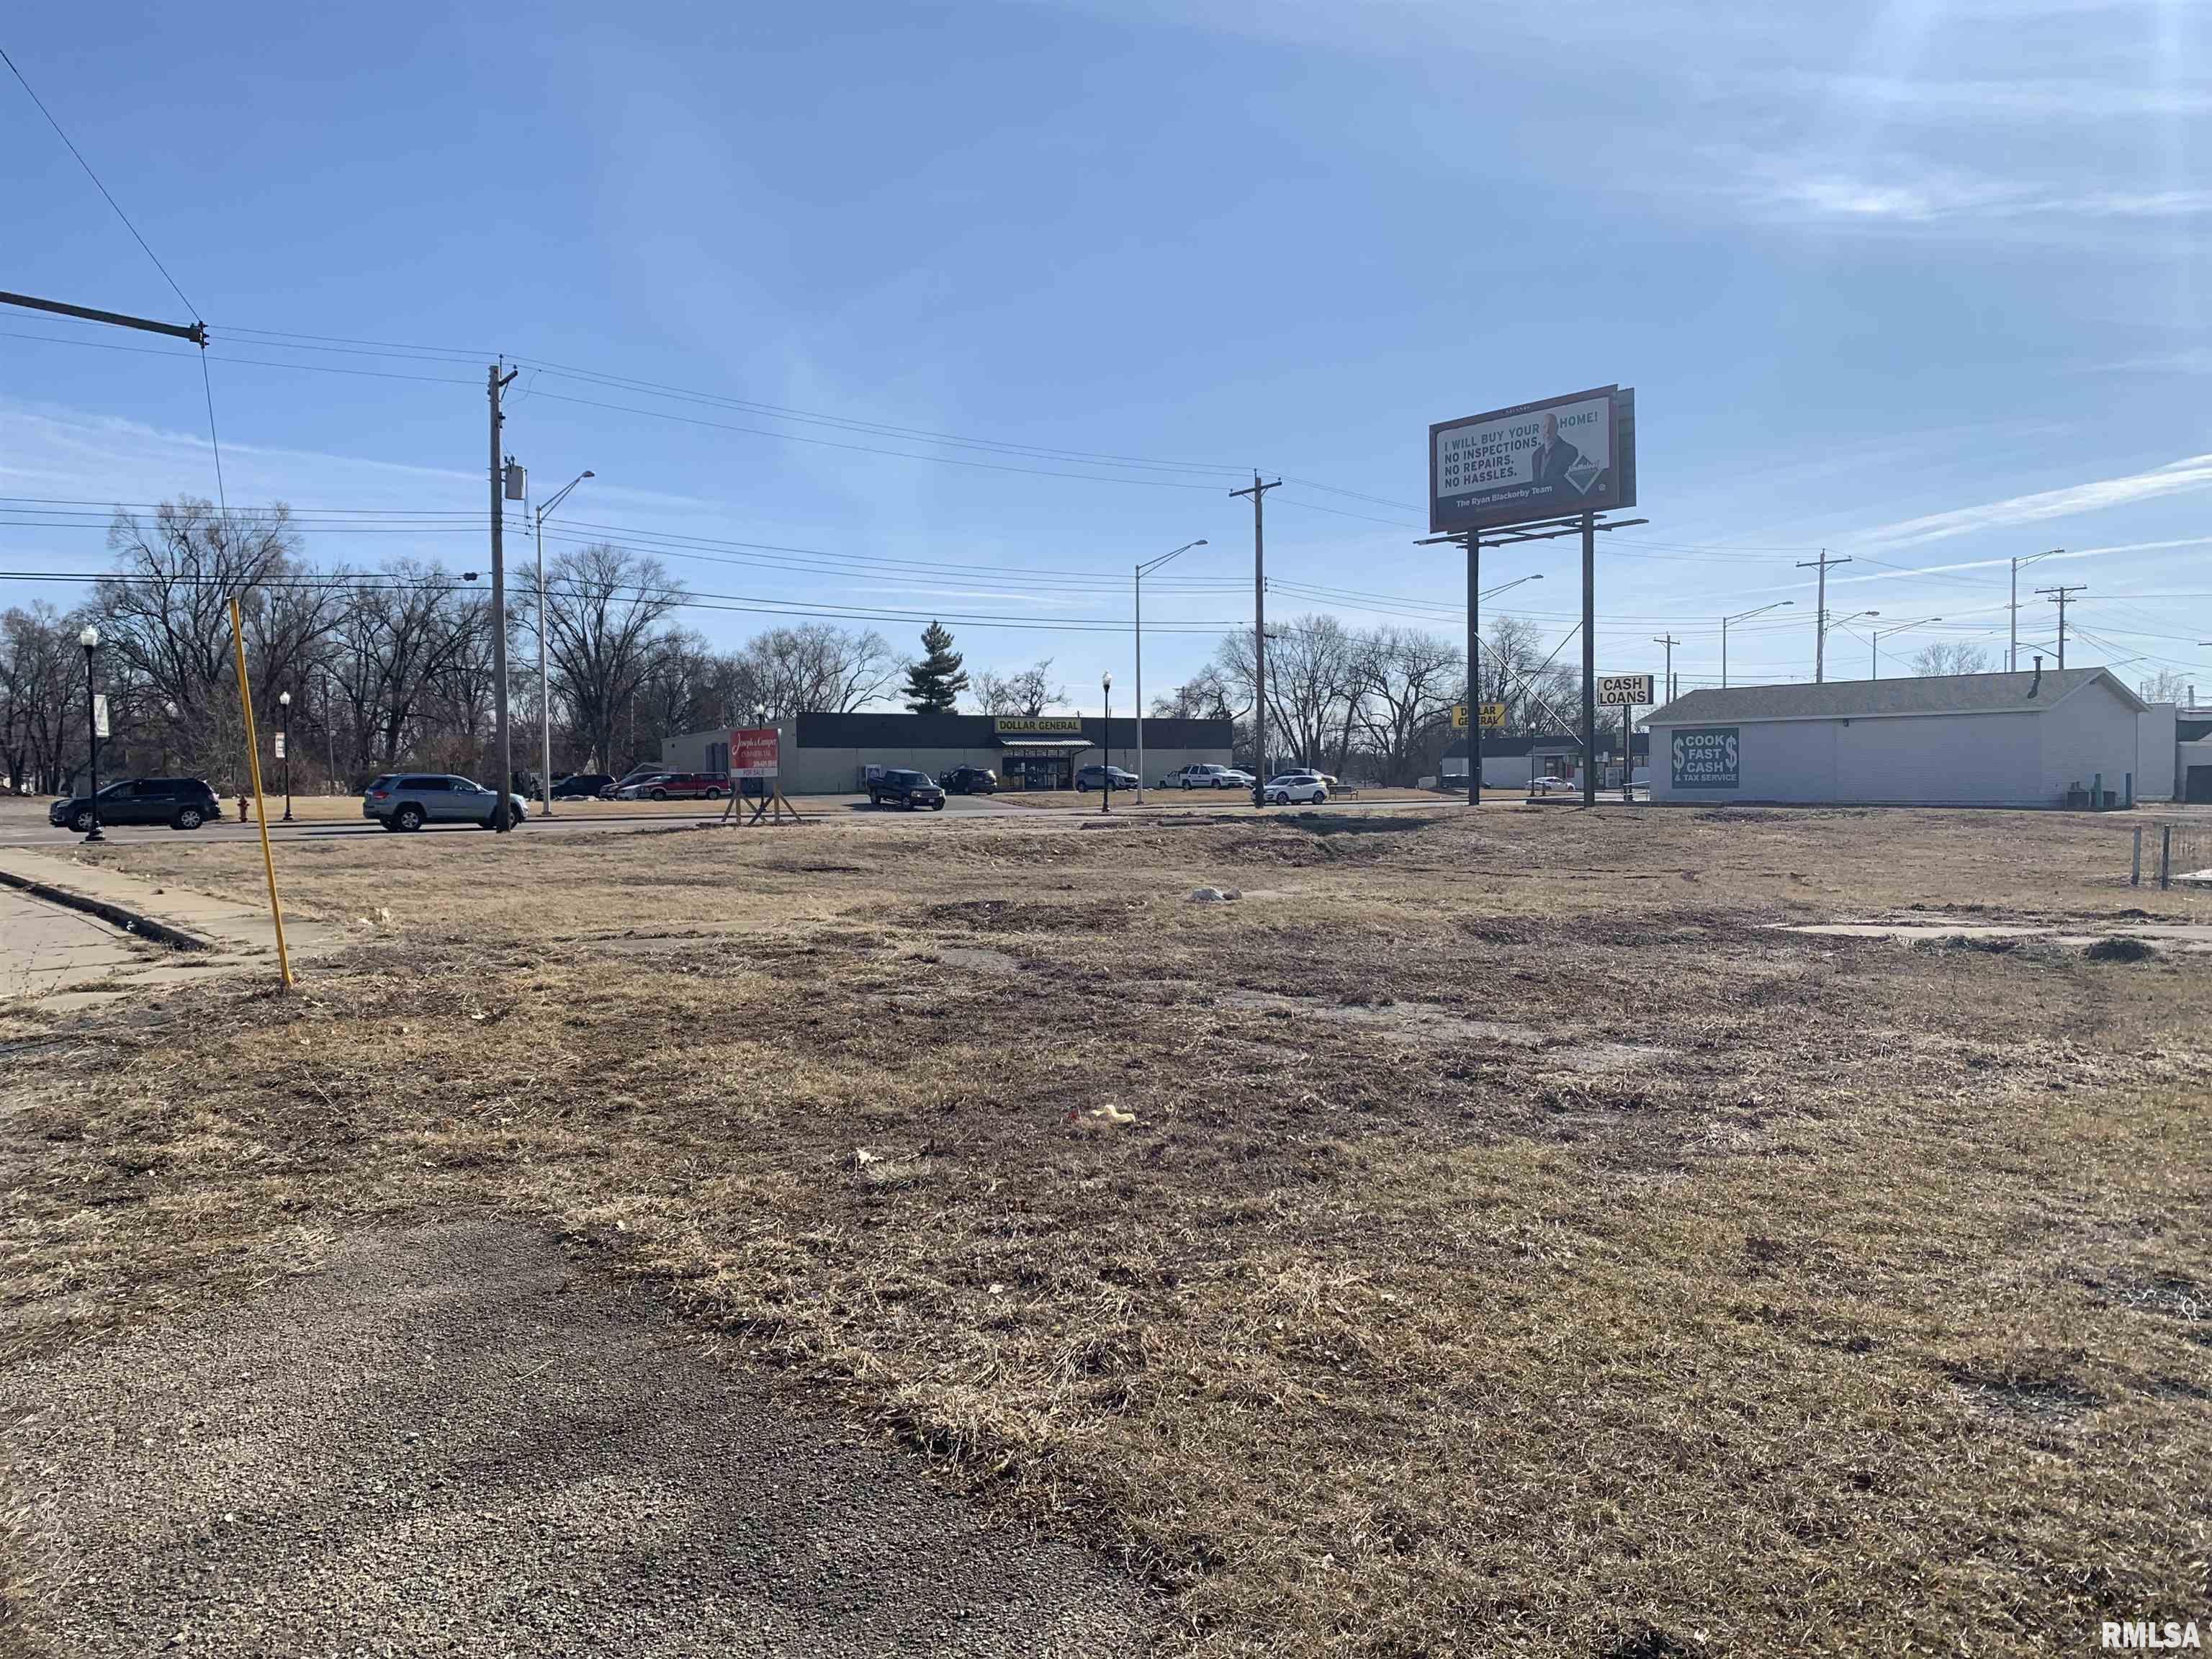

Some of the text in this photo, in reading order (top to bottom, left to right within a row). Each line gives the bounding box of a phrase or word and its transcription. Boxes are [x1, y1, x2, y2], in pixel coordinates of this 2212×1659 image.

[1444, 411, 1599, 451] I WILL BUY YOUR HOME!
[1444, 436, 1542, 464] NO INSPECTIONS.
[1444, 454, 1514, 477] NO REPAIRS.
[1444, 467, 1517, 489] NO HASSLES.
[1456, 485, 1553, 508] The Ryan Blackorby Team
[1604, 678, 1642, 691] CASH
[1600, 691, 1646, 704] LOANS
[1461, 706, 1496, 716] DLAR
[999, 721, 1078, 730] DOLLAR GENERAL
[1686, 735, 1725, 747] COOK
[1689, 748, 1722, 760] FAST
[1686, 762, 1724, 773] CASH
